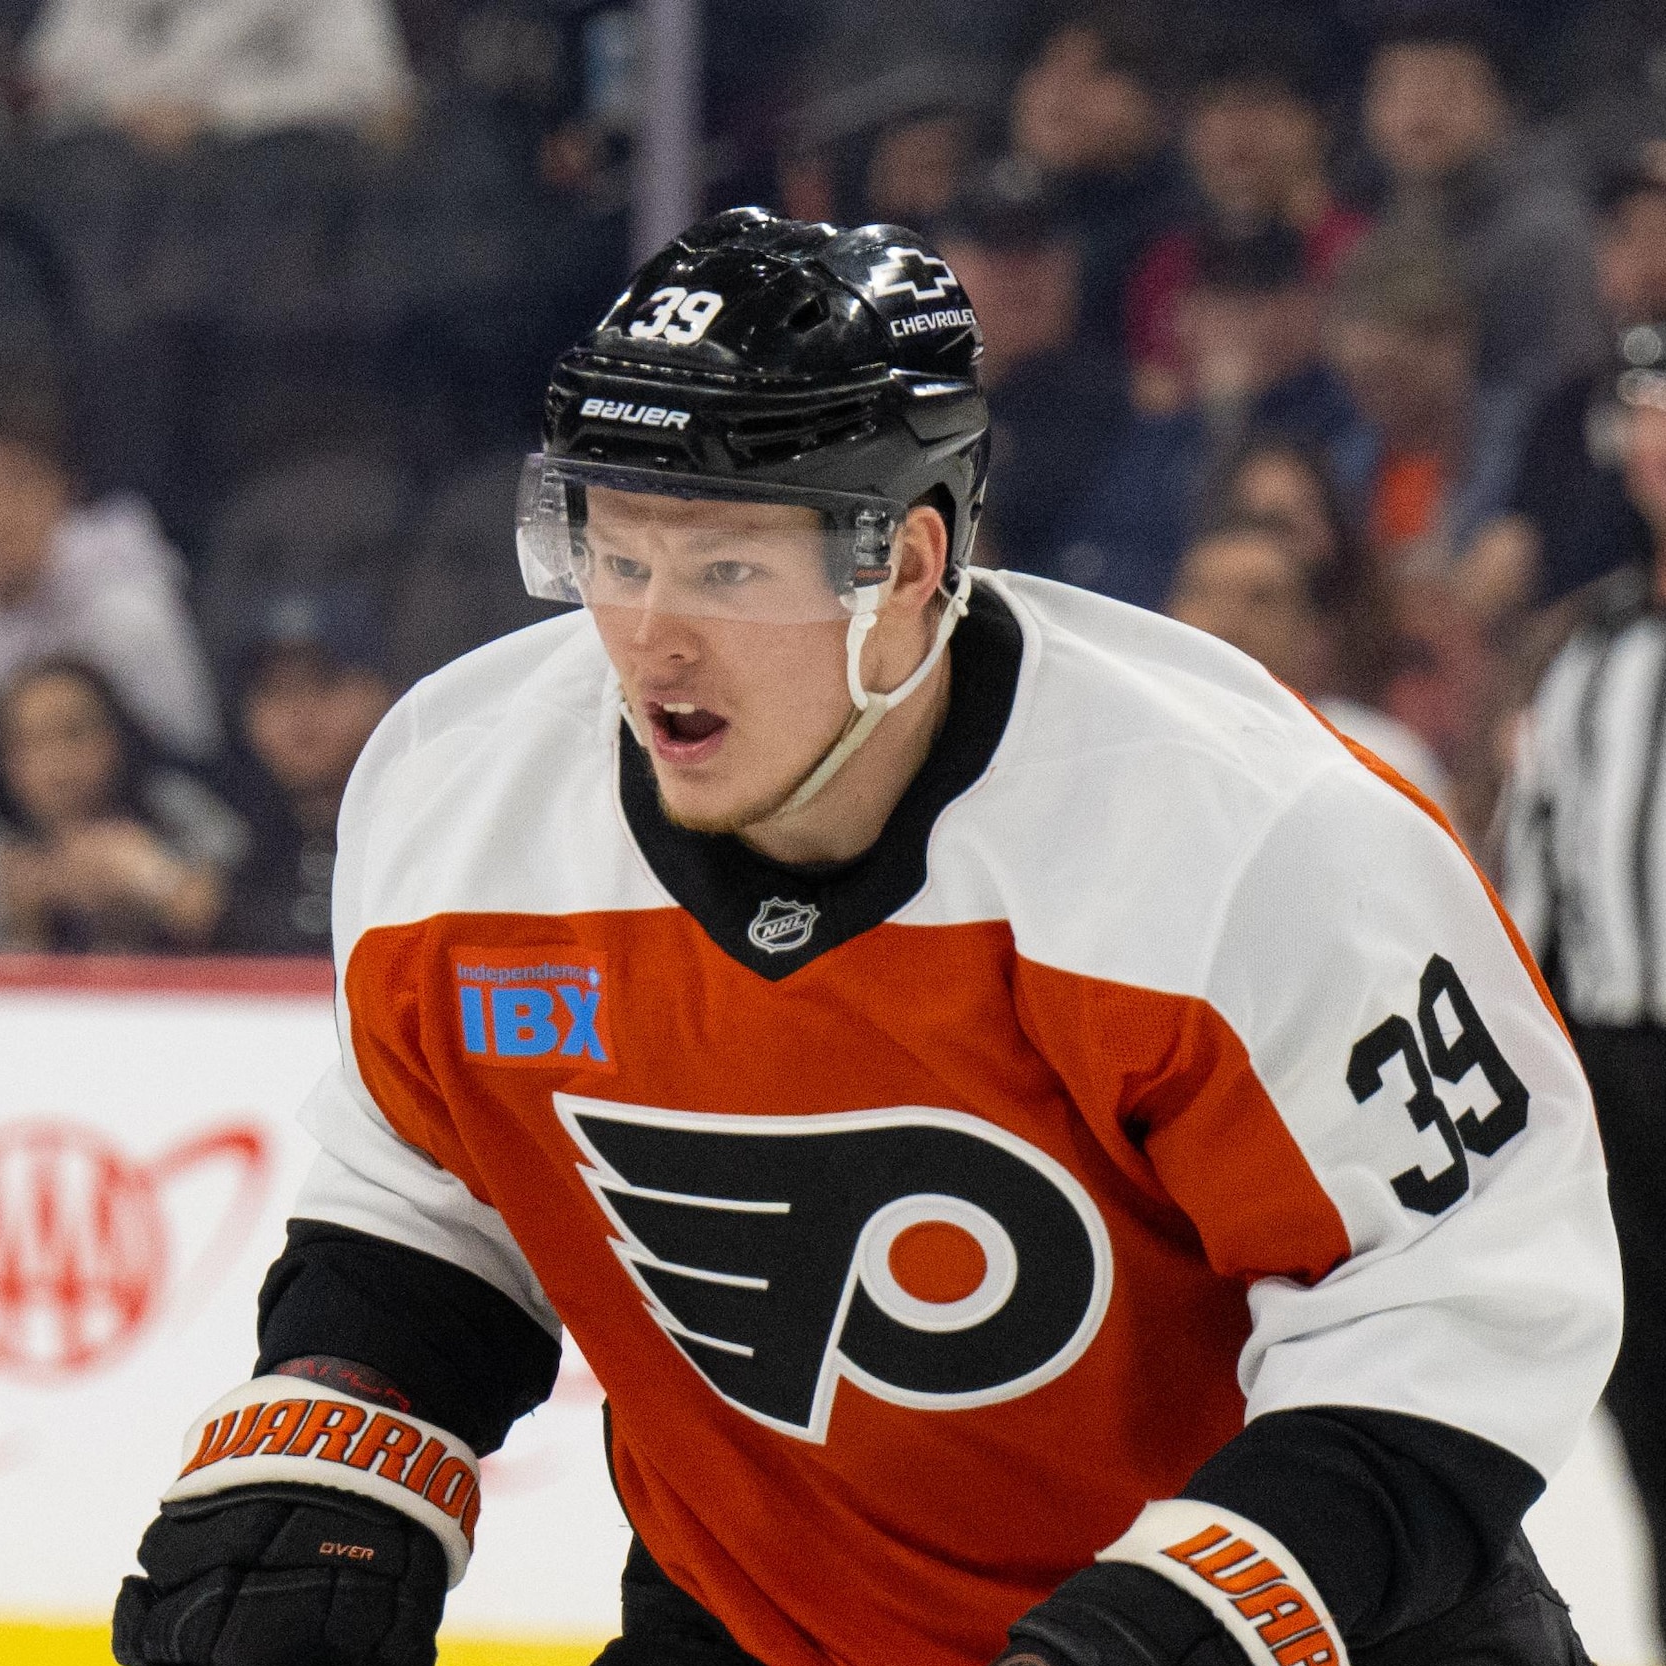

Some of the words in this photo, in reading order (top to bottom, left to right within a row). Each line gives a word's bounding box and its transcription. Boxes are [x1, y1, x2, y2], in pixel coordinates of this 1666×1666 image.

[629, 286, 724, 345] 39
[889, 308, 977, 338] CHEVROLET
[579, 397, 691, 431] BAUER
[761, 915, 805, 938] NHL
[460, 985, 608, 1062] IBX
[1345, 952, 1530, 1216] 39
[319, 1541, 375, 1561] OVER
